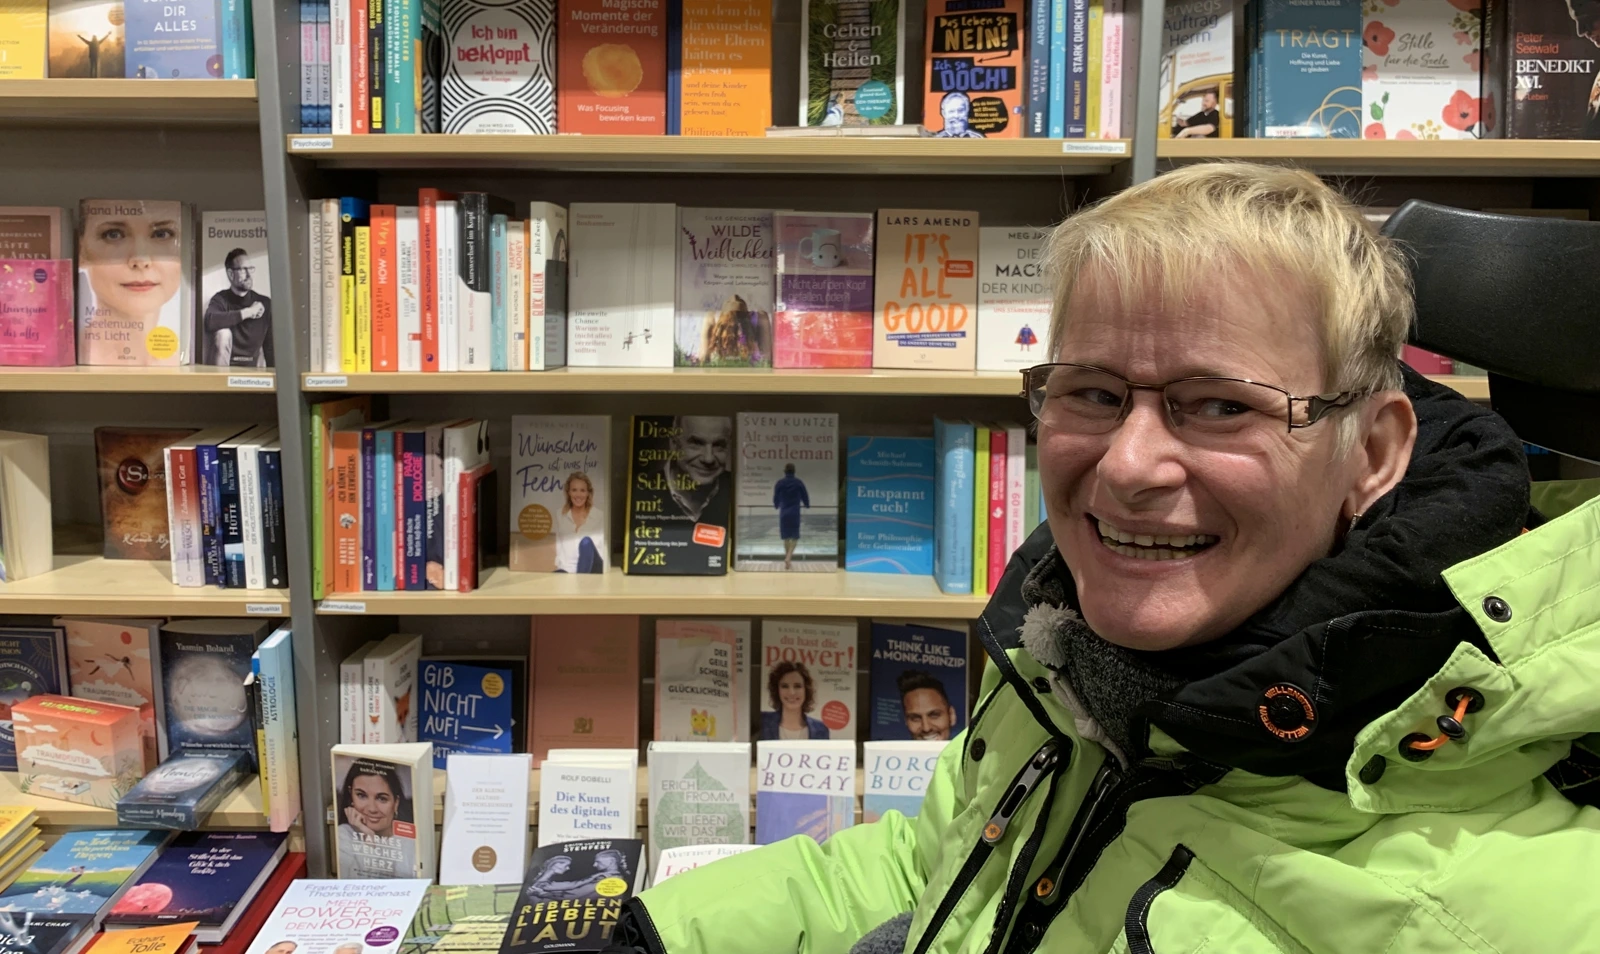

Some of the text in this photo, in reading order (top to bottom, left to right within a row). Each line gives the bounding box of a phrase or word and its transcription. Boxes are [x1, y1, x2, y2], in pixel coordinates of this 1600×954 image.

[164, 7, 186, 16] DIR
[602, 0, 658, 10] Magische
[685, 6, 760, 16] von dem du
[572, 10, 652, 20] Momente der
[154, 21, 196, 32] ALLES
[581, 23, 658, 36] Veränderung
[685, 20, 702, 31] dir
[1164, 14, 1218, 31] Auftrag
[472, 25, 517, 40] Ich bin
[824, 23, 881, 38] Gehen
[1276, 27, 1353, 48] TRÄGT
[685, 34, 764, 46] deine Eltern
[945, 25, 1008, 51] NEIN!
[1073, 11, 1084, 73] STARK DURCH
[1170, 30, 1210, 47] Herrn
[1398, 33, 1434, 51] Stille
[1517, 33, 1543, 43] Peter
[848, 41, 857, 51] &
[1516, 43, 1558, 54] Seewald
[685, 48, 742, 61] hätten es
[824, 53, 881, 67] Heilen
[1403, 56, 1418, 66] die
[1420, 56, 1449, 68] Seele
[1516, 60, 1594, 73] BENEDIKT
[684, 66, 731, 78] gelesen
[941, 68, 1008, 90] DOCH!
[1515, 75, 1542, 89] XVI.
[596, 105, 629, 114] Focusing
[599, 114, 634, 122] bewirken
[294, 140, 331, 148] Psychologie
[84, 205, 143, 216] Jana Haas
[467, 211, 475, 228] Kopf
[887, 217, 971, 227] LARS AMEND
[467, 230, 474, 240] im
[712, 225, 761, 237] WILDE
[324, 221, 334, 288] Der PLANER
[343, 237, 351, 274] dummies
[693, 237, 773, 260] Weiblichkei
[1017, 249, 1039, 259] DIE
[900, 267, 952, 299] ALL
[85, 307, 111, 316] Mein
[884, 301, 968, 332] GOOD
[85, 318, 144, 331] Seelenweg
[85, 331, 130, 341] ins Licht
[307, 378, 346, 386] Organisation
[744, 417, 834, 427] SVEN KUNTZE
[639, 421, 683, 438] Diese
[743, 431, 833, 443] Alt sein wie ein
[518, 432, 597, 457] Wünschen
[639, 448, 685, 466] ganze
[743, 444, 833, 460] Gentleman
[404, 452, 412, 476] PAAR
[549, 459, 562, 471] ist
[564, 461, 580, 470] was
[413, 456, 423, 501] DIOLOGIE
[516, 465, 564, 497] Feen
[637, 473, 700, 490] Scheiße
[857, 486, 925, 501] Entspannt
[636, 495, 663, 512] mit
[872, 502, 909, 513] euch!
[634, 522, 662, 538] der
[633, 547, 666, 566] Zeit
[176, 643, 234, 652] Yasmin Boland
[780, 635, 838, 649] du hast die
[887, 639, 951, 656] THINK LIKE
[714, 649, 728, 657] DER
[765, 645, 855, 668] power!
[873, 649, 965, 668] A MONK-PRINZIP
[709, 658, 728, 667] GEILE
[424, 664, 454, 688] GIB
[700, 667, 729, 678] SCHEISS
[668, 684, 729, 698] GLÜCKLICHSEIN
[713, 680, 729, 688] VOM
[268, 676, 277, 721] ASTROLOGIE
[424, 689, 482, 718] NICHT
[424, 715, 459, 740] AUF!
[36, 749, 90, 764] TRAUMDEUTER
[762, 753, 850, 772] JORGE
[581, 776, 612, 784] DOBELLI
[662, 780, 695, 791] ERICH
[762, 772, 850, 791] BUCAY
[556, 791, 610, 803] Die Kunst
[686, 792, 734, 802] FROMM
[550, 804, 620, 819] des digitalen
[574, 819, 612, 830] Lebens
[684, 815, 726, 826] LIEBEN
[664, 826, 714, 836] WIR DAS
[352, 831, 401, 848] STARKES
[352, 843, 403, 860] WEICHES
[363, 857, 393, 871] HERZ
[281, 907, 403, 918] POWER FÜR
[521, 899, 622, 915] REBELLEN
[285, 918, 387, 930] DEN KOPF
[516, 908, 620, 927] LIEBEN
[126, 936, 165, 944] Eckhart
[510, 921, 617, 947] LAUT
[130, 941, 165, 954] Tolle
